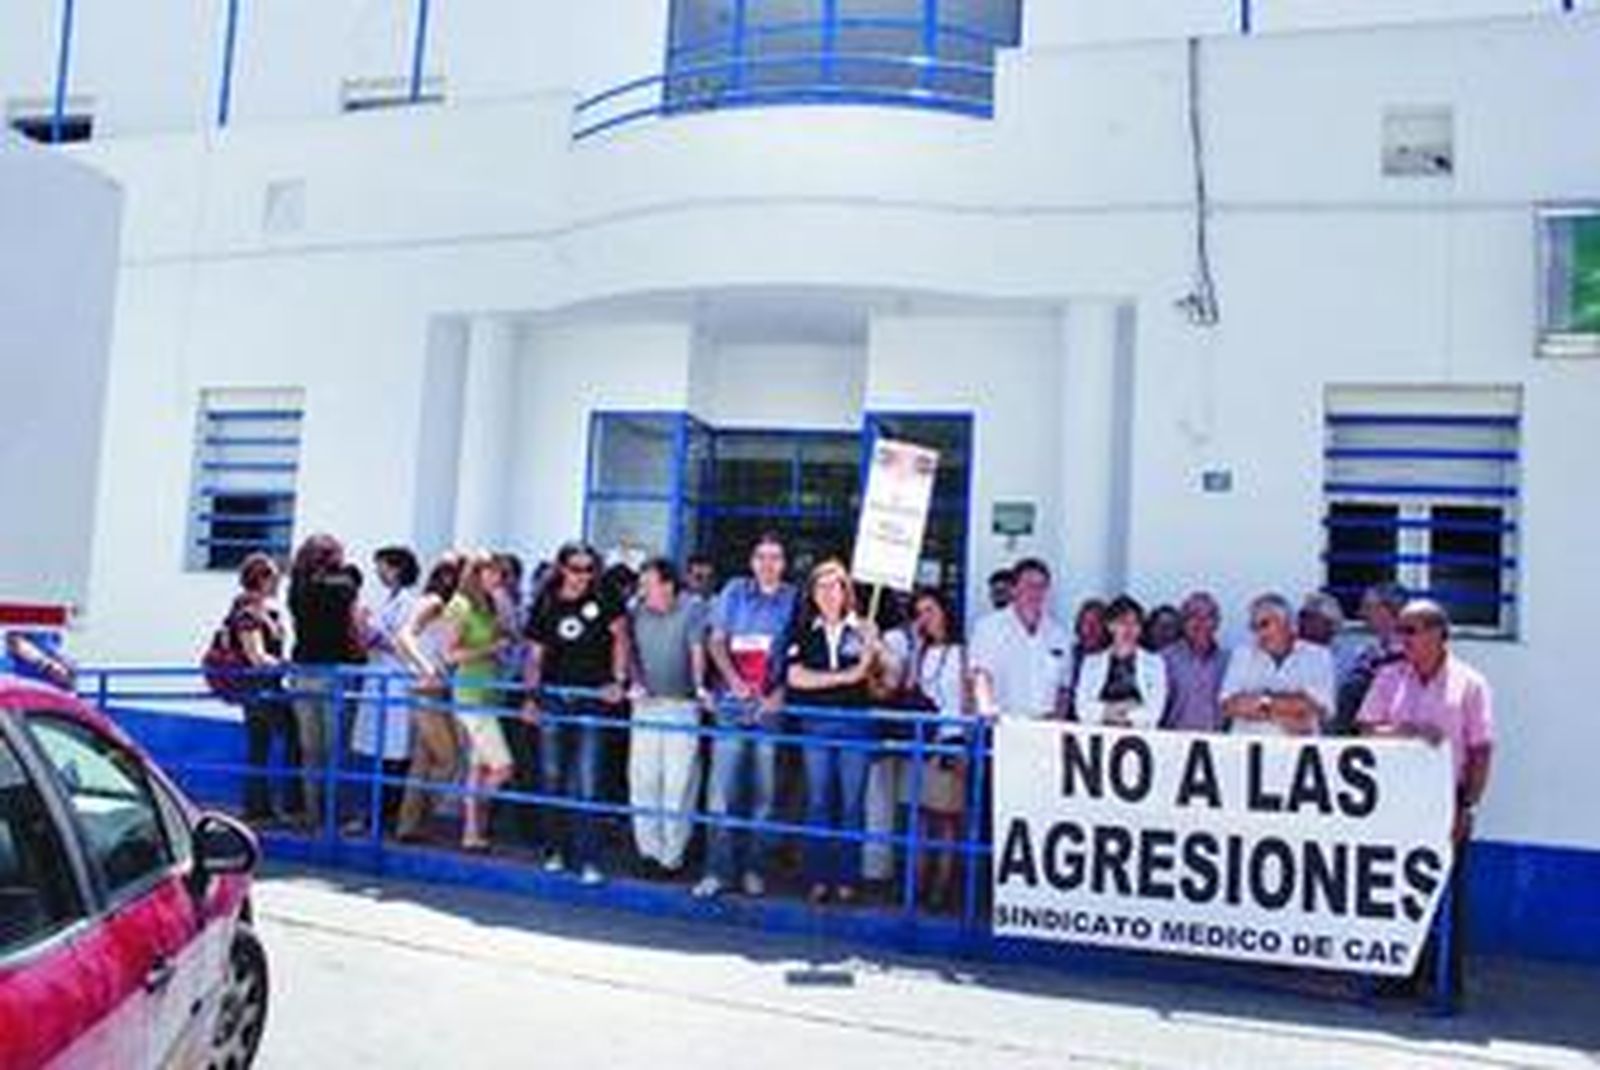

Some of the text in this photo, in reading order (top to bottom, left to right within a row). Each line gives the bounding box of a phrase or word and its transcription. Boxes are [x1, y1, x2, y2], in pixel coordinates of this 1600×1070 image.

[1062, 732, 1377, 818] NO A LAS
[998, 817, 1441, 922] AGRESIONES
[996, 905, 1151, 939] SINDICATO
[1160, 921, 1281, 953] MEDICO
[1293, 934, 1333, 958] DE
